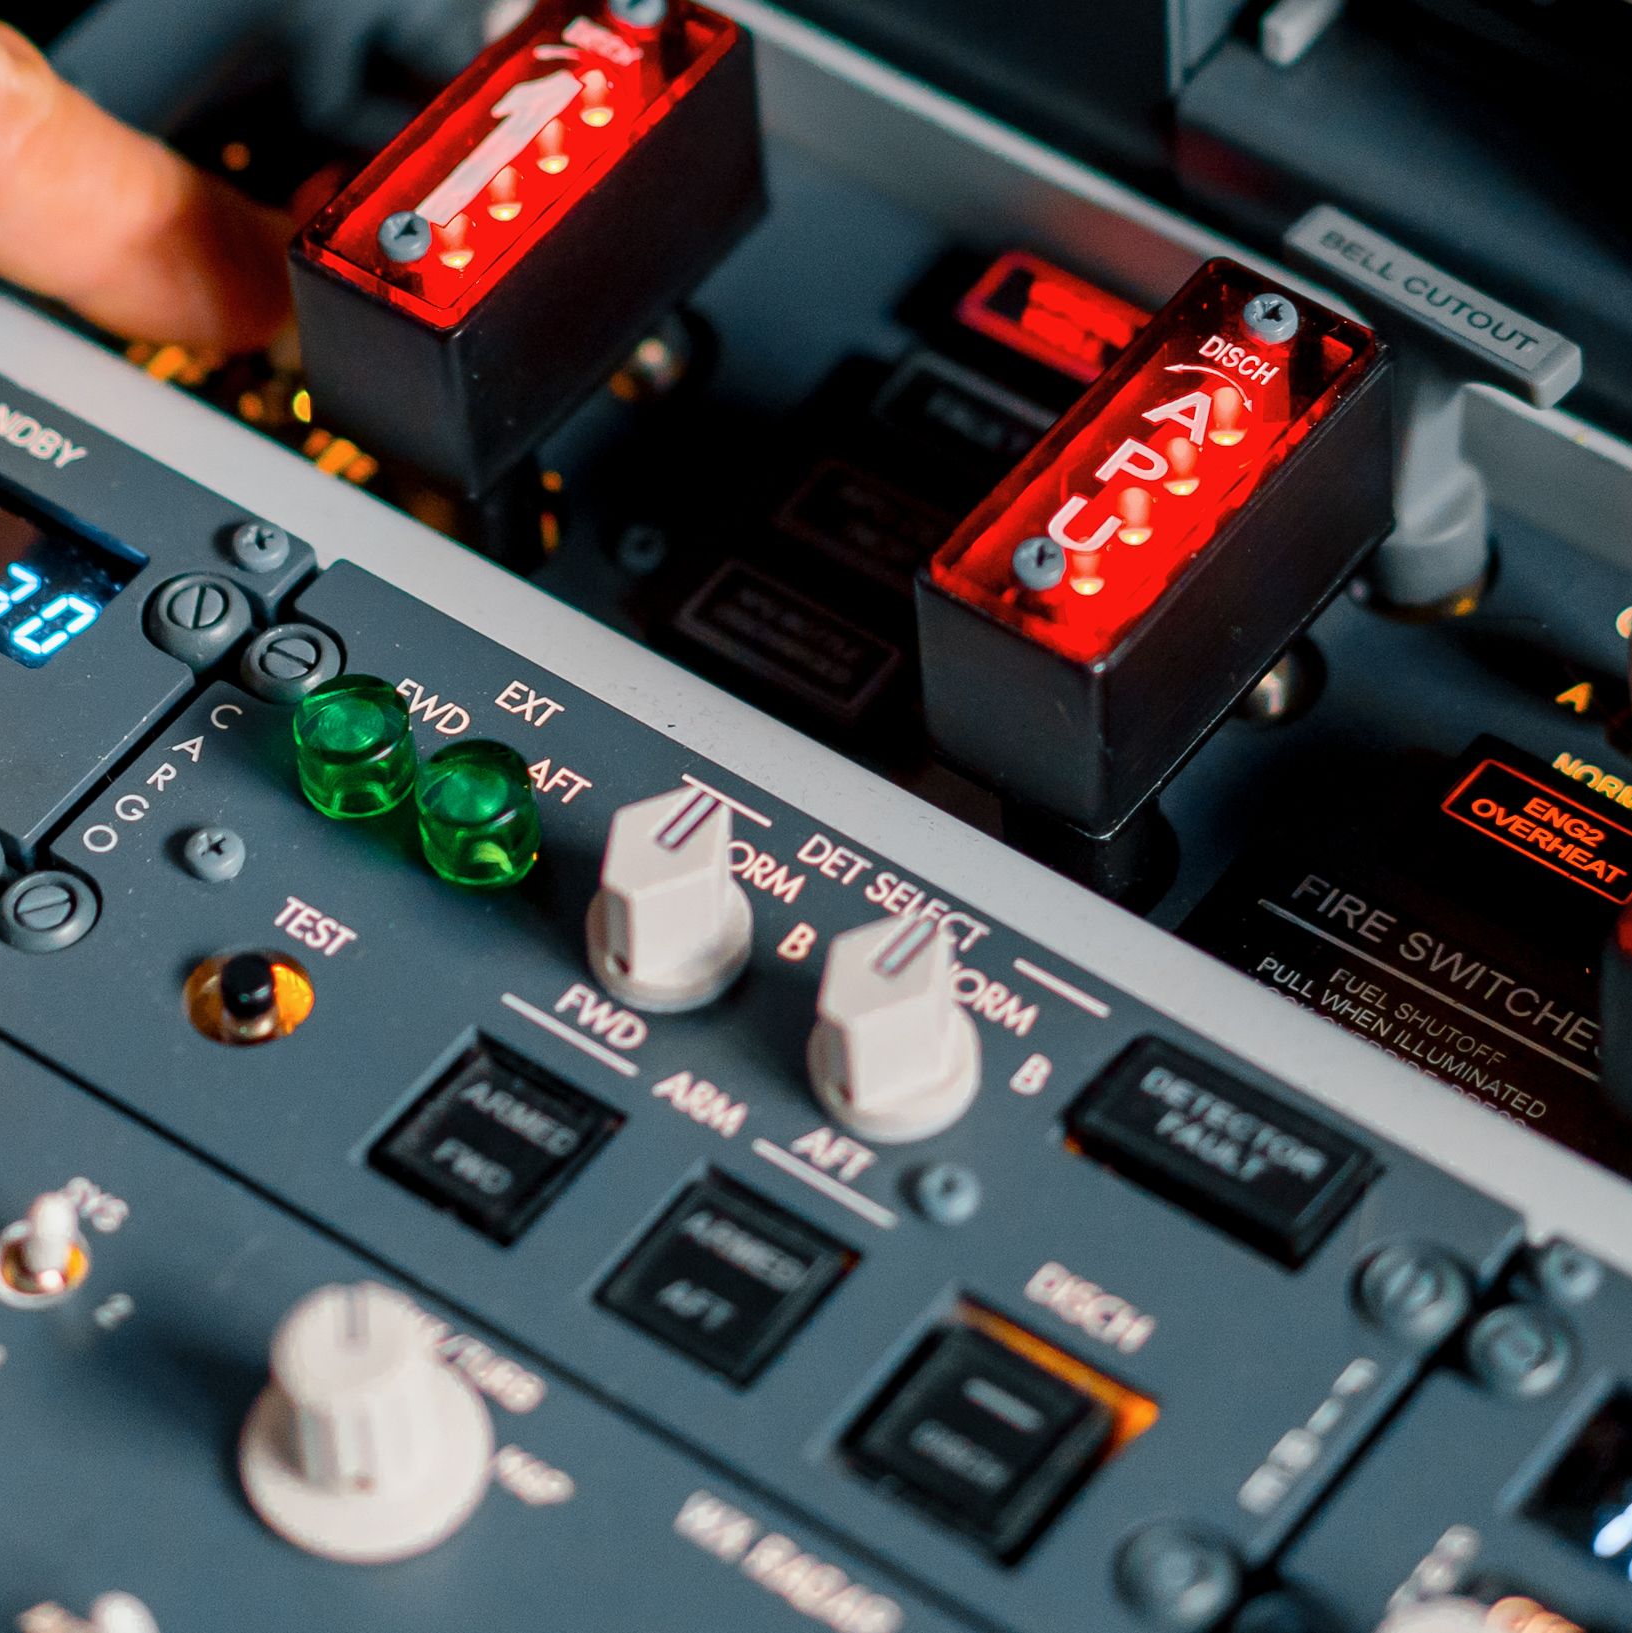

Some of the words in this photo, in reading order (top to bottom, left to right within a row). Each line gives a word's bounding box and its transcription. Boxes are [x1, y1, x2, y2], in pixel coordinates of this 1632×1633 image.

[413, 68, 584, 228] 1
[1319, 229, 1397, 283] BELL
[1403, 272, 1539, 355] CUTOUT
[1197, 334, 1280, 386] DISCH
[1048, 390, 1215, 554] APU
[395, 676, 471, 736] FWD
[494, 679, 565, 728] EXT
[1556, 681, 1593, 714] A
[82, 703, 243, 854] CARGO
[527, 758, 592, 804] AFT
[1470, 798, 1627, 885] OVERHEAT
[1523, 796, 1607, 847] ENG2
[727, 840, 807, 904] ORM
[797, 832, 873, 886] DET
[272, 895, 358, 957] TEST
[775, 921, 817, 963] B
[1292, 873, 1397, 945] FIRE
[554, 982, 648, 1051] FWD
[950, 960, 1040, 1037] ORM
[1329, 968, 1389, 1011] FUEL
[1393, 1002, 1507, 1067] SHUTOFF
[1256, 956, 1315, 1000] PULL
[1320, 989, 1394, 1039] WHEN
[1392, 1029, 1547, 1120] ILLUMINATED
[652, 1068, 749, 1139] ARM
[1010, 1052, 1053, 1096] B
[464, 1079, 579, 1157] ARMED
[1140, 1065, 1328, 1180] DETECTOR
[790, 1126, 878, 1182] AFT
